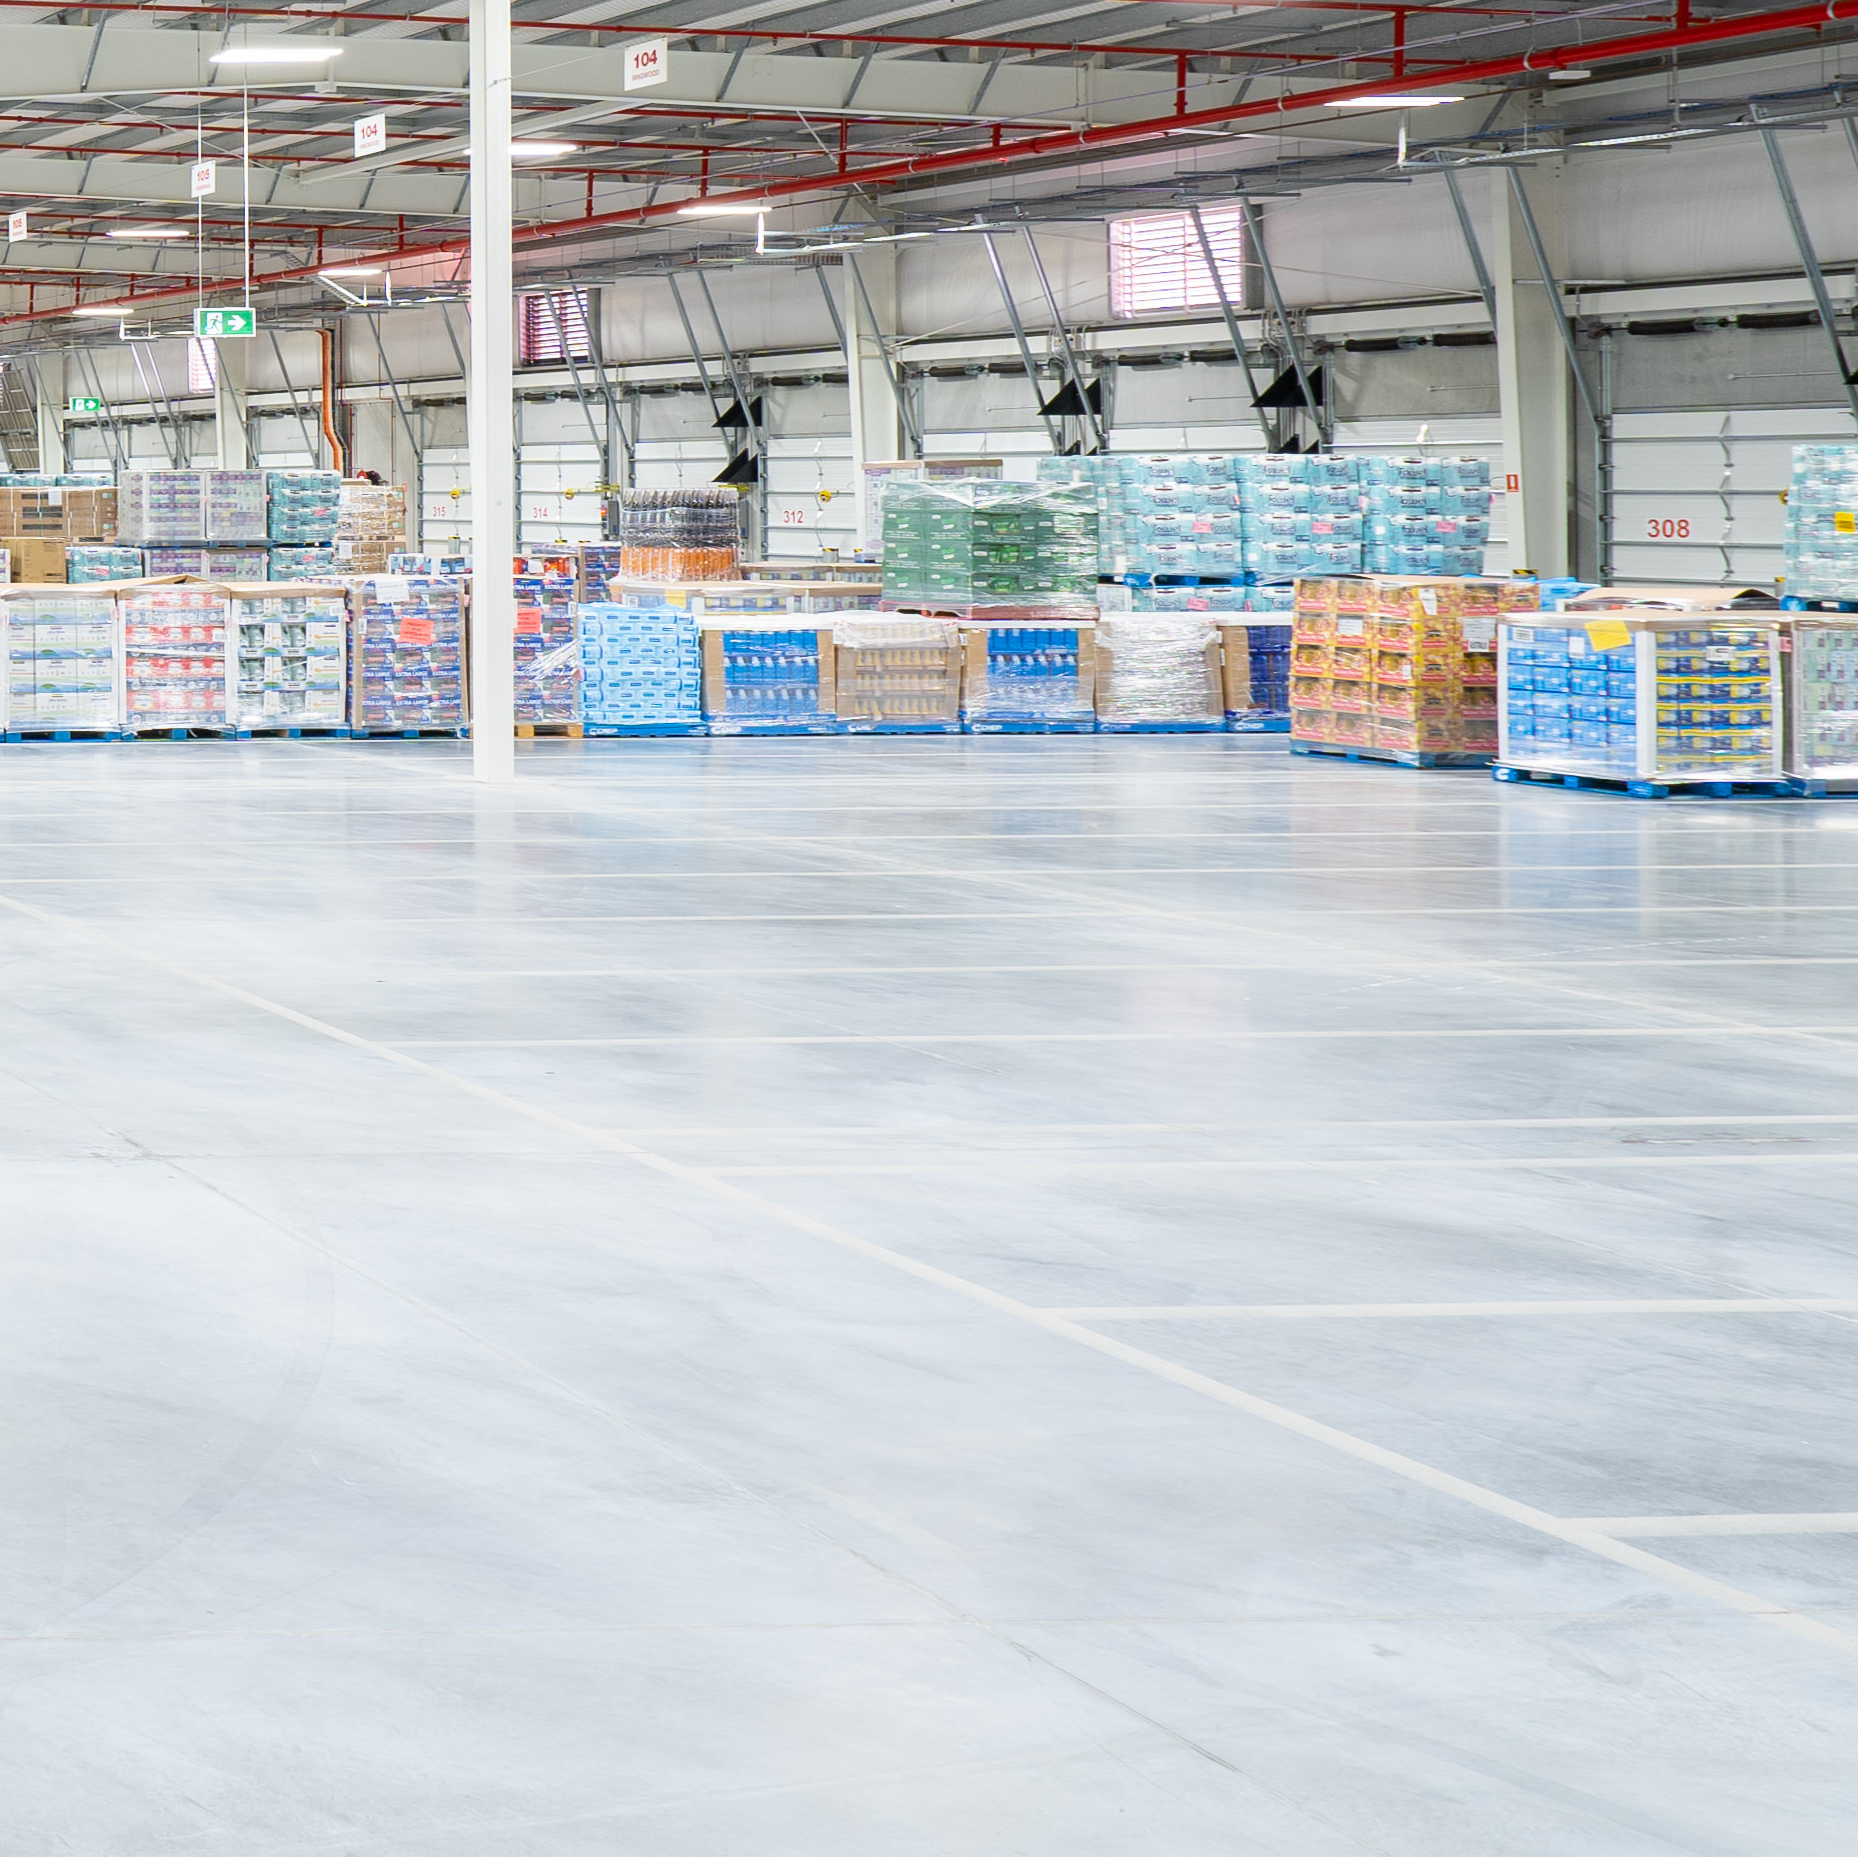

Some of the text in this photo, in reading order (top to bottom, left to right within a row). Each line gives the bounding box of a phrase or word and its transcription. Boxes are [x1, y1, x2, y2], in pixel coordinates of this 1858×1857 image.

[634, 49, 658, 69] 104
[361, 123, 378, 140] 104
[432, 506, 446, 518] 315
[533, 507, 548, 519] 314
[783, 510, 804, 524] 312
[1647, 518, 1691, 539] 308
